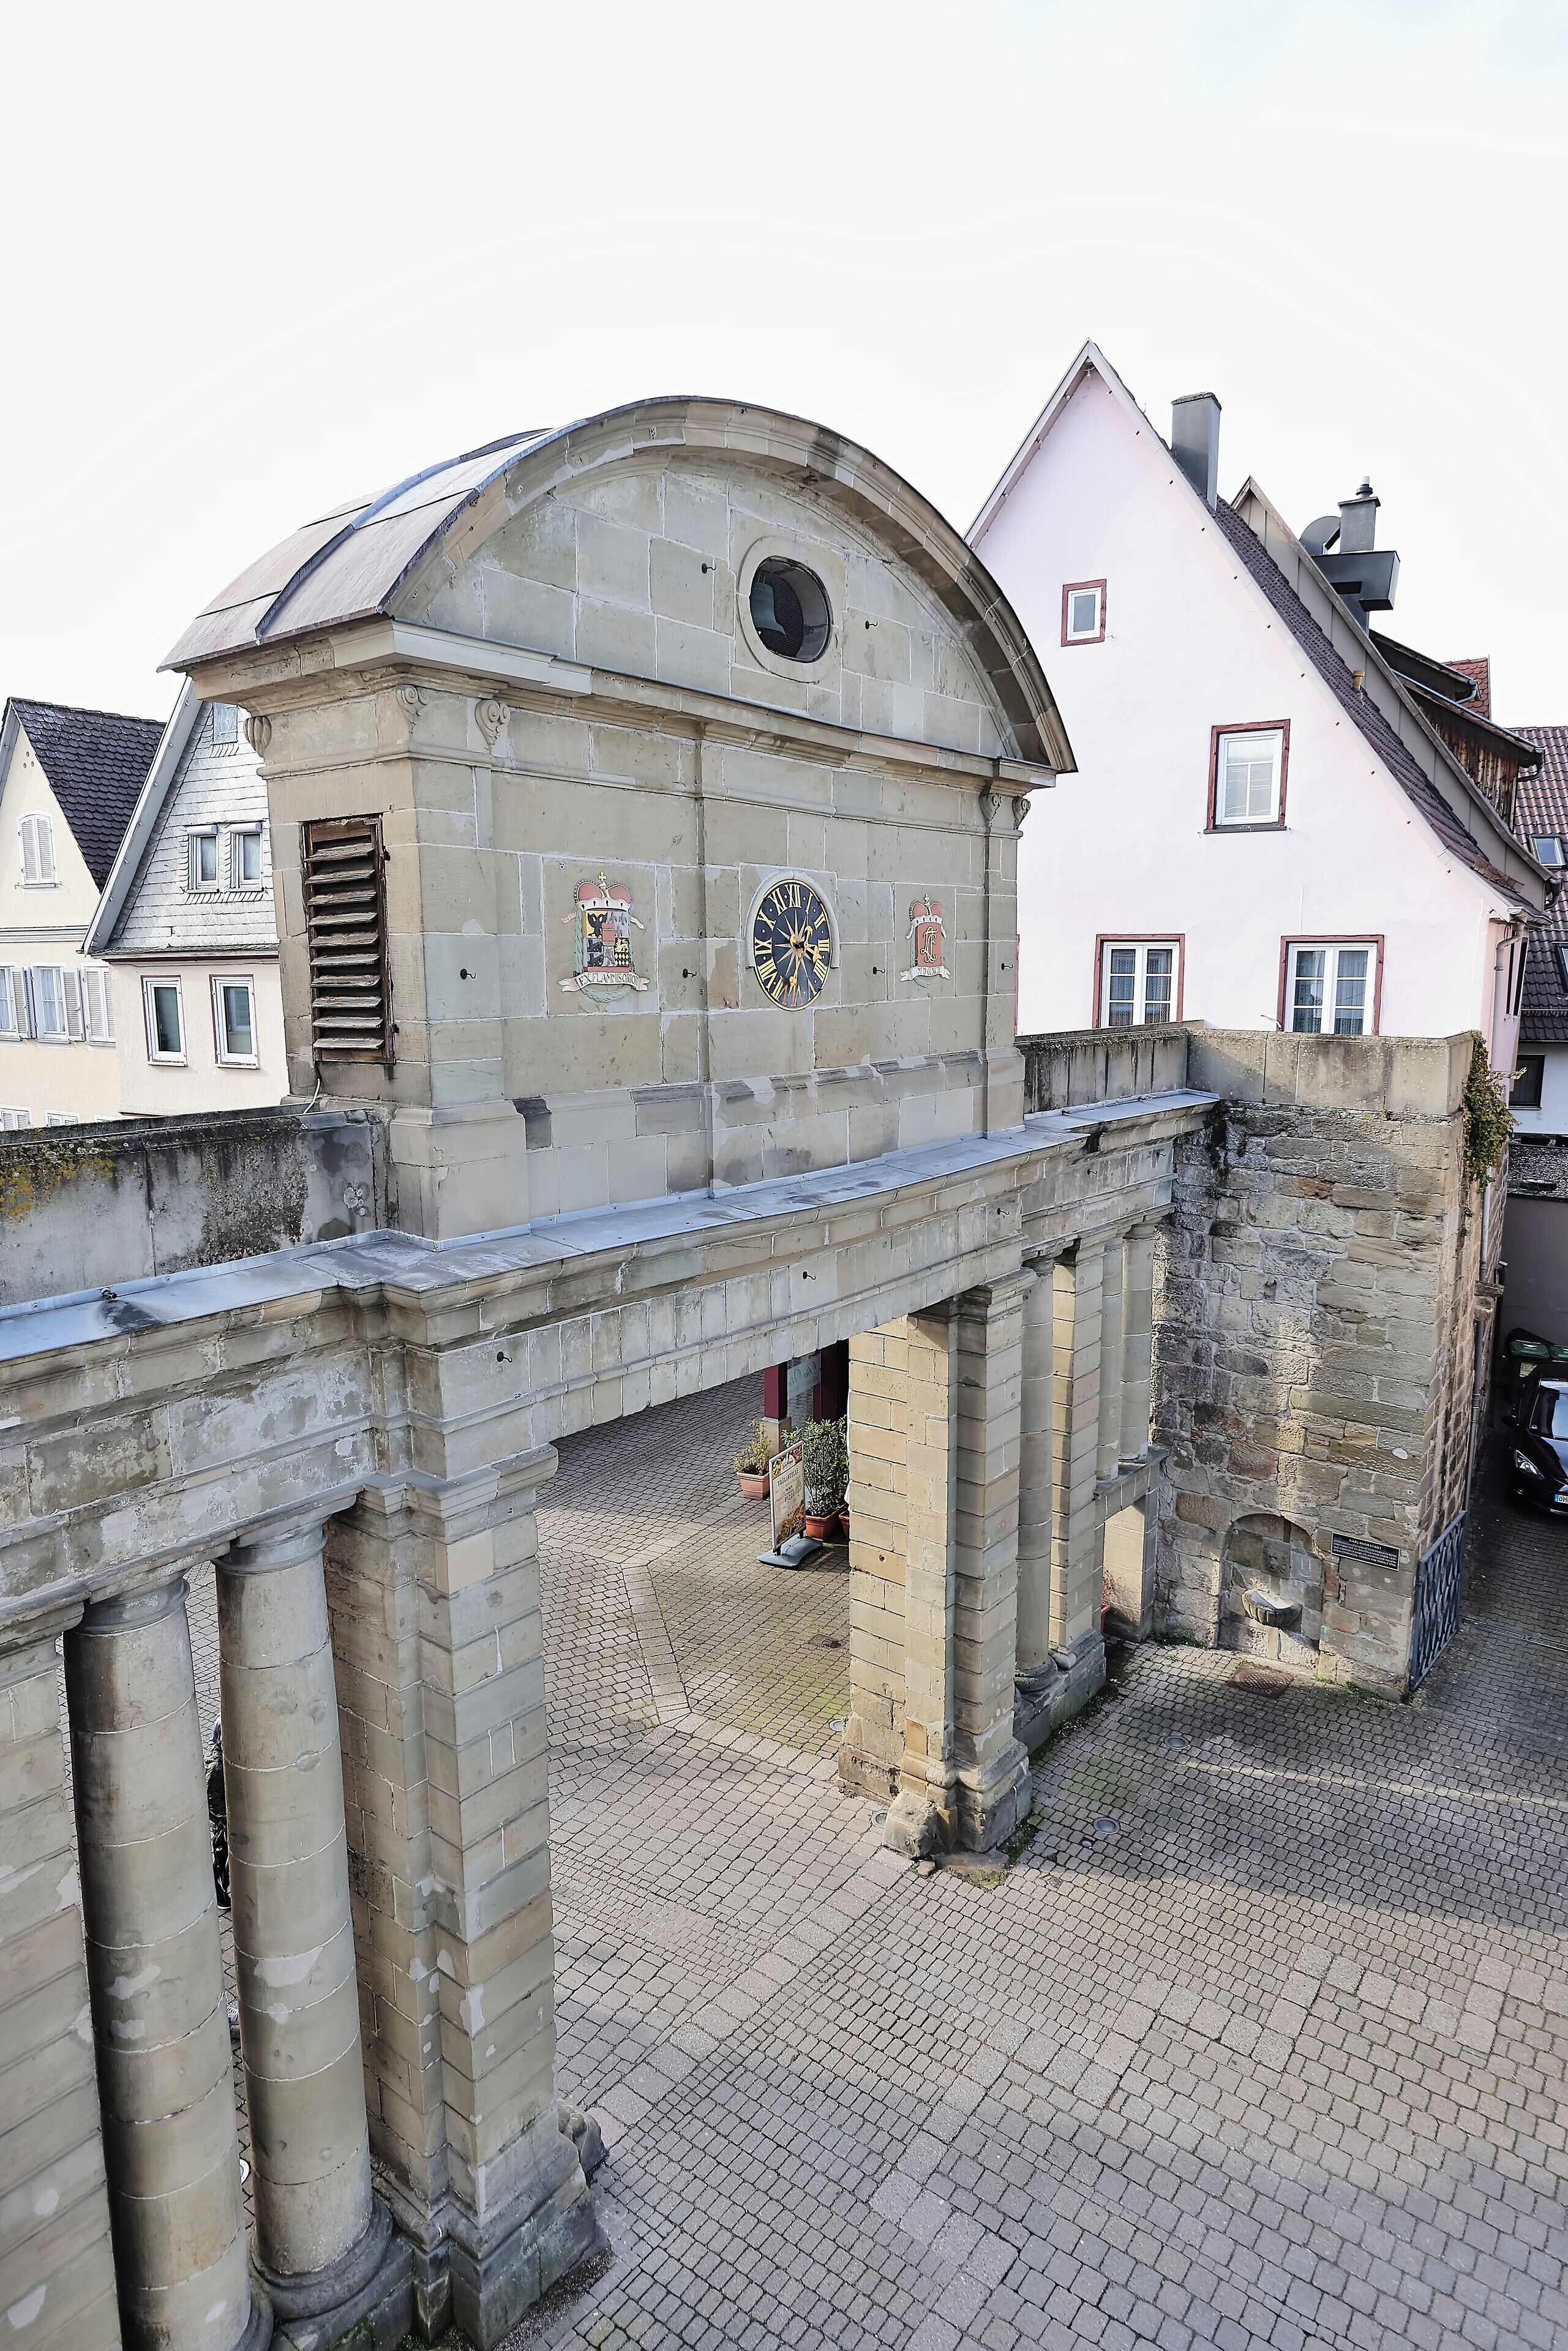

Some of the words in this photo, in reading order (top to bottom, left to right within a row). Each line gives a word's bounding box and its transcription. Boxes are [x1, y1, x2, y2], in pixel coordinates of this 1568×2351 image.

[768, 888, 788, 916] XI
[784, 884, 802, 909] XII
[805, 892, 814, 915] I
[757, 909, 776, 931] X
[814, 911, 827, 930] II
[754, 937, 773, 956] IX
[817, 937, 830, 953] III
[579, 974, 591, 986] EX
[593, 973, 622, 984] FLAMMIS
[757, 956, 778, 991] VIII
[778, 1468, 799, 1486] TAGLIATELLE
[784, 1492, 795, 1502] PIZZA
